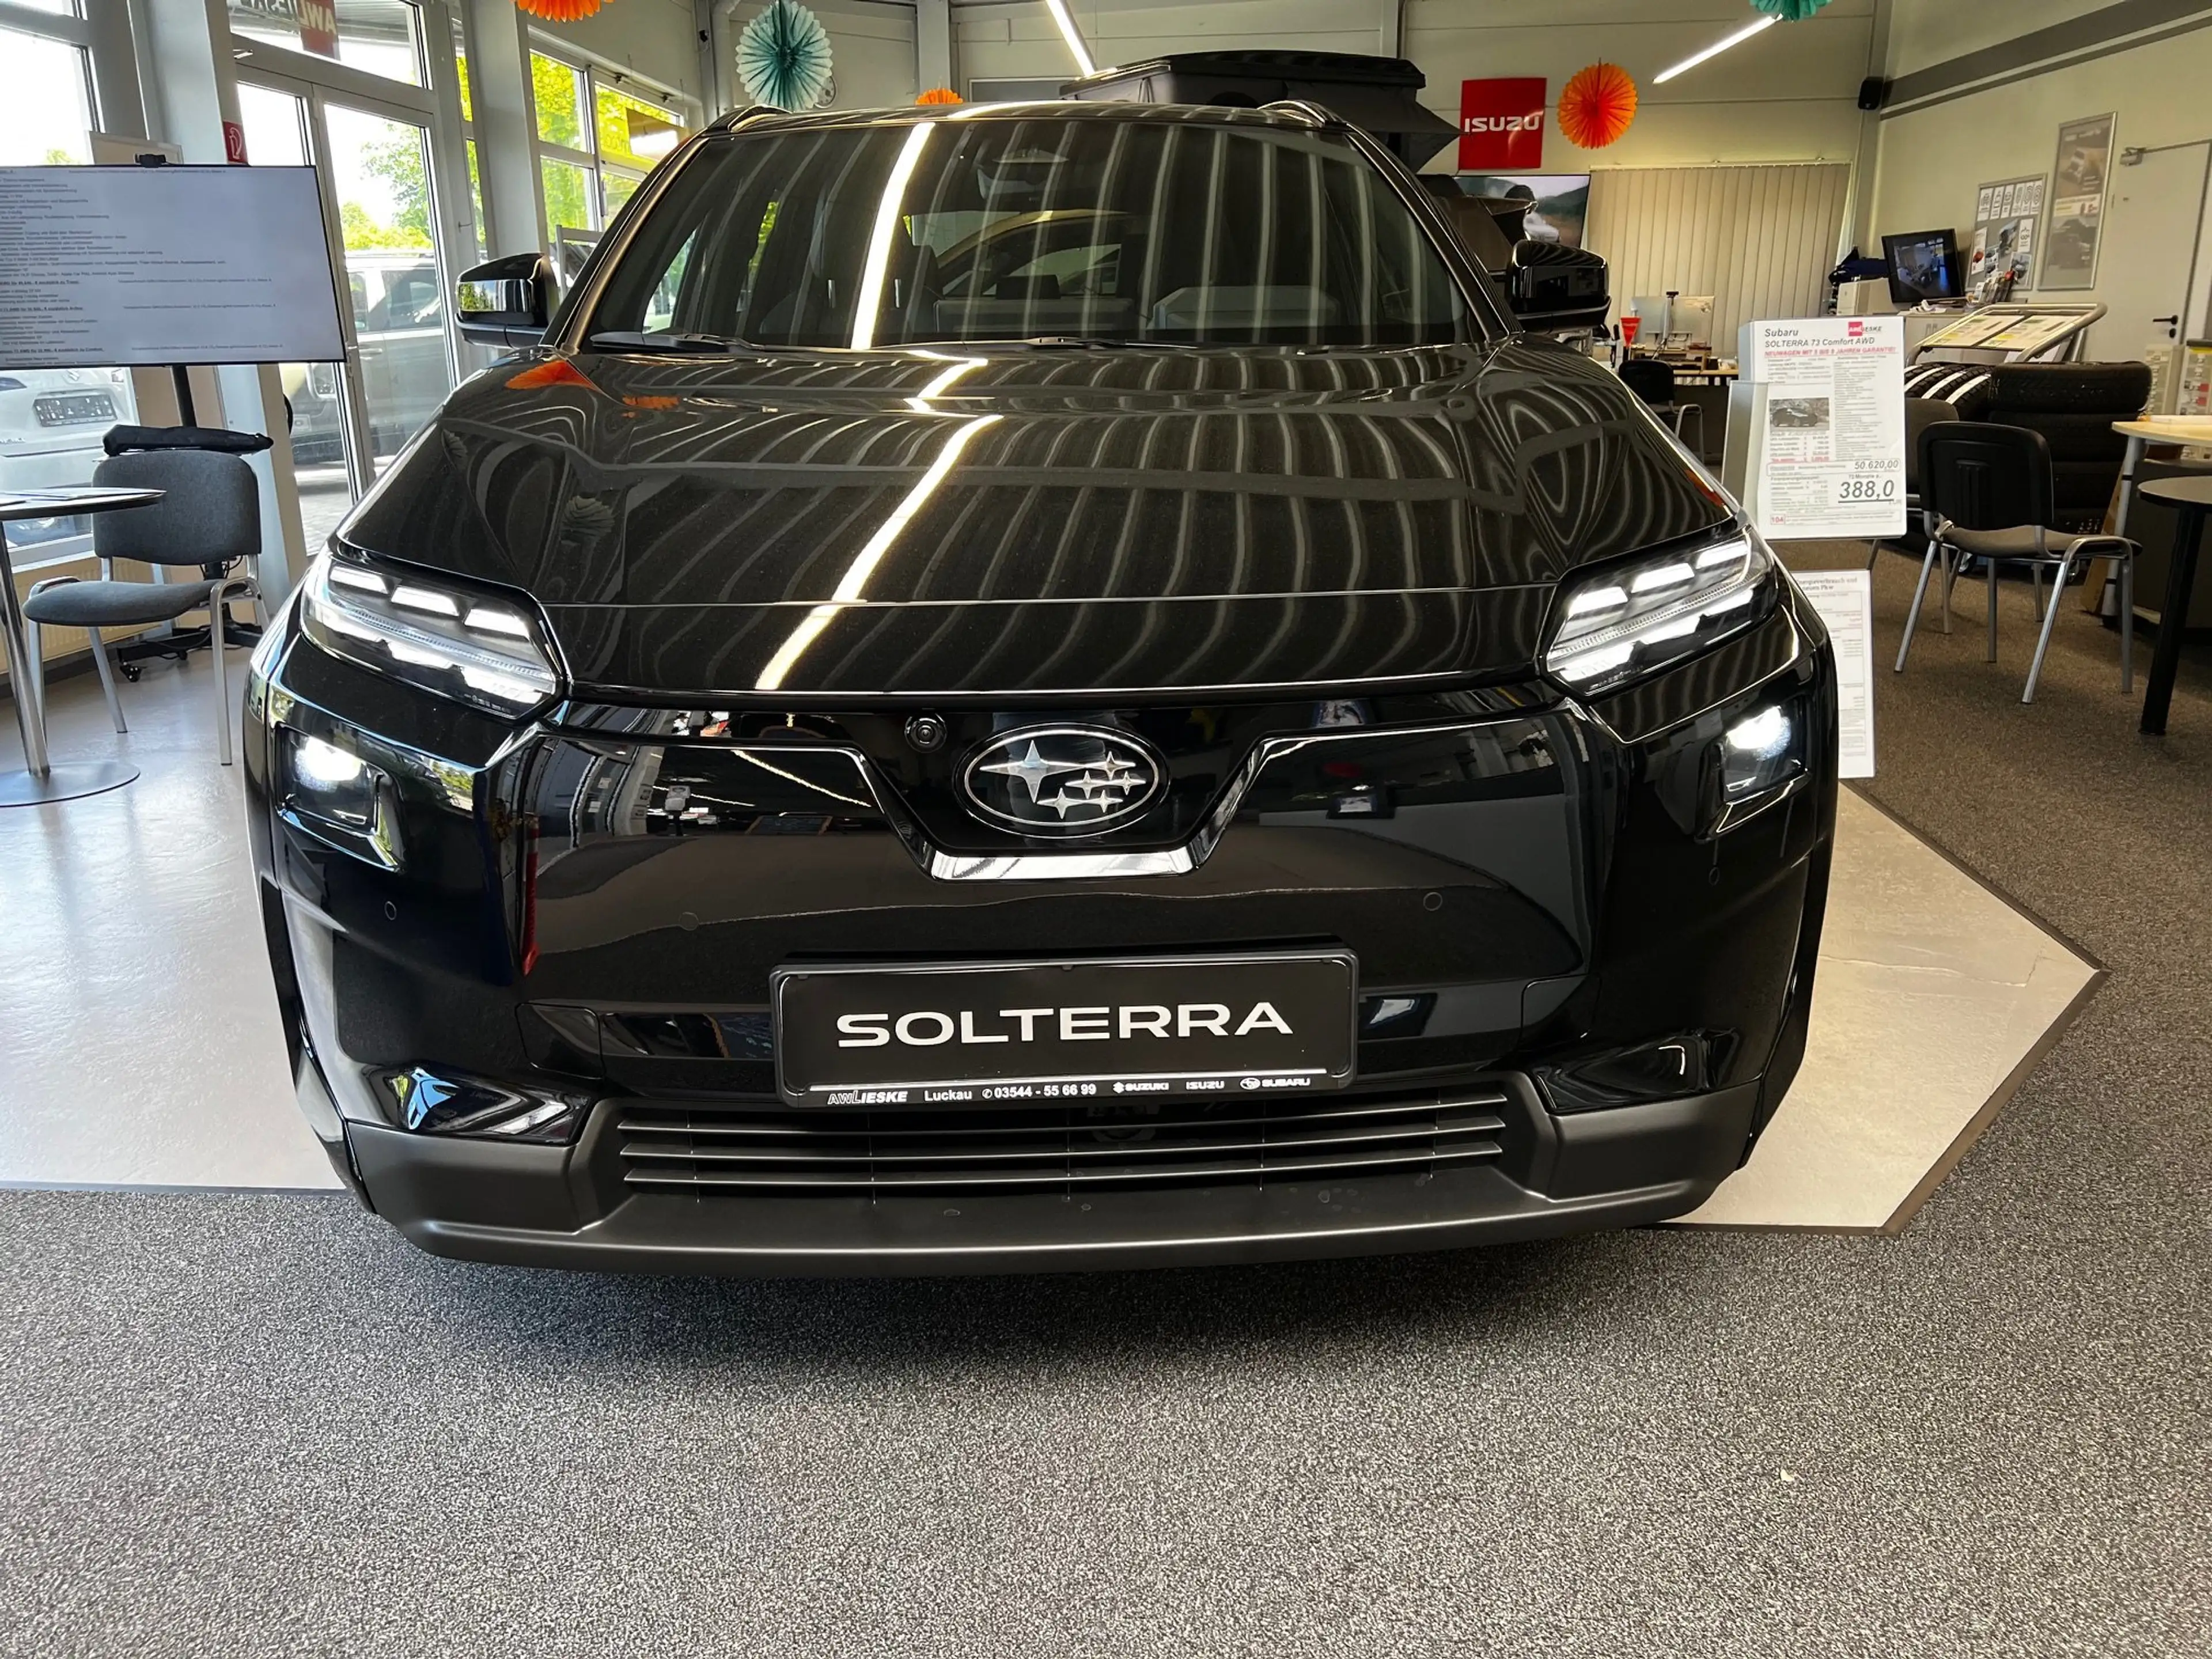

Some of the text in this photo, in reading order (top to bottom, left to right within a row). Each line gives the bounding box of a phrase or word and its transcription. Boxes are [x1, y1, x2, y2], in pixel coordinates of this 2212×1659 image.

[1464, 116, 1539, 132] ISUZU
[1764, 328, 1799, 337] Subaru
[1765, 339, 1808, 347] SOLTERRA
[1822, 338, 1854, 346] Comfort
[1855, 460, 1899, 469] 50.620,00
[1840, 480, 1894, 500] 388,0
[836, 1001, 1294, 1048] SOLTERRA
[924, 1089, 972, 1101] Luckau
[994, 1086, 1032, 1099] 03544
[1043, 1085, 1060, 1096] 55
[1062, 1084, 1078, 1096] 66
[1081, 1083, 1097, 1096] 99
[1125, 1082, 1169, 1091] SUZUKI
[1186, 1081, 1225, 1090] ISUZU
[1262, 1078, 1311, 1087] SUBARU
